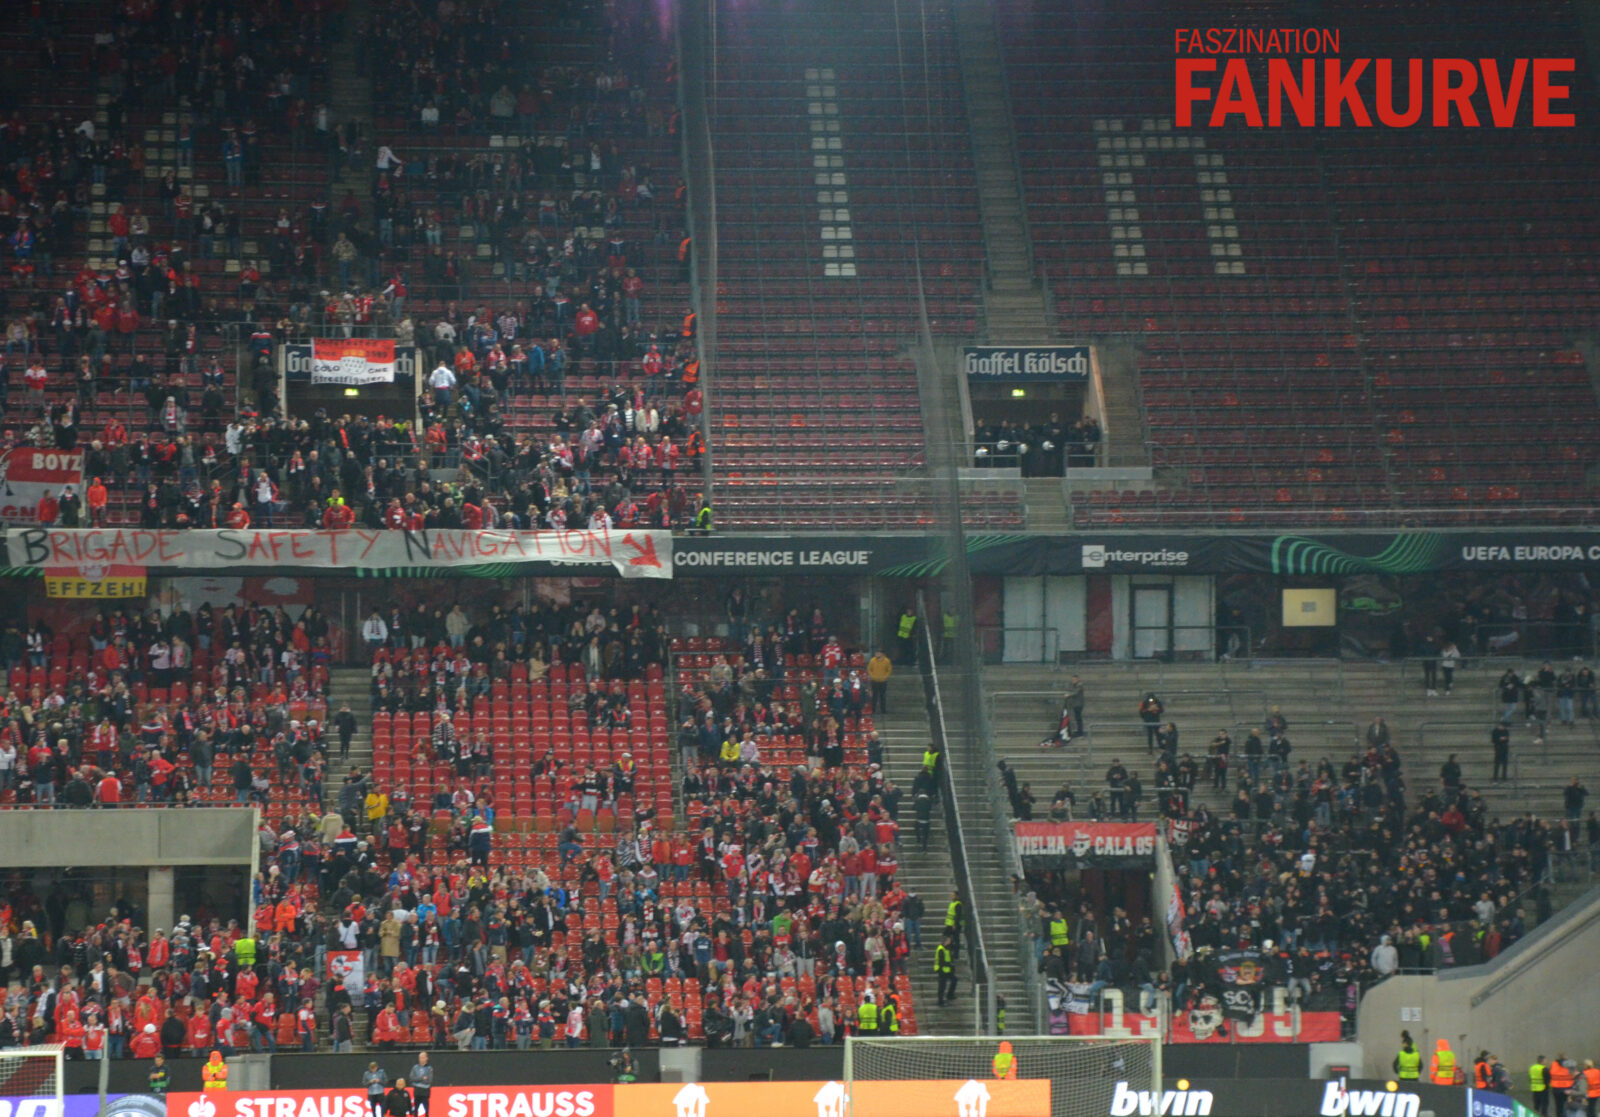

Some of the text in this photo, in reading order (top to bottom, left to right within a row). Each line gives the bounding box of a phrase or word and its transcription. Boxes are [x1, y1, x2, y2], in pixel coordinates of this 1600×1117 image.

[32, 453, 83, 471] BOYZ
[20, 527, 612, 565] BRIGADE SAFETY NAVIGATION
[1462, 546, 1511, 561] UEFA
[1514, 546, 1584, 561] EUROPA
[674, 550, 869, 566] CONFERENCE LEAGUE
[47, 581, 145, 597] EFFZEH!
[1094, 835, 1133, 856] CALA
[447, 1091, 595, 1117] STRAUSS
[1110, 1079, 1214, 1117] bwin
[1320, 1080, 1420, 1117] bwin
